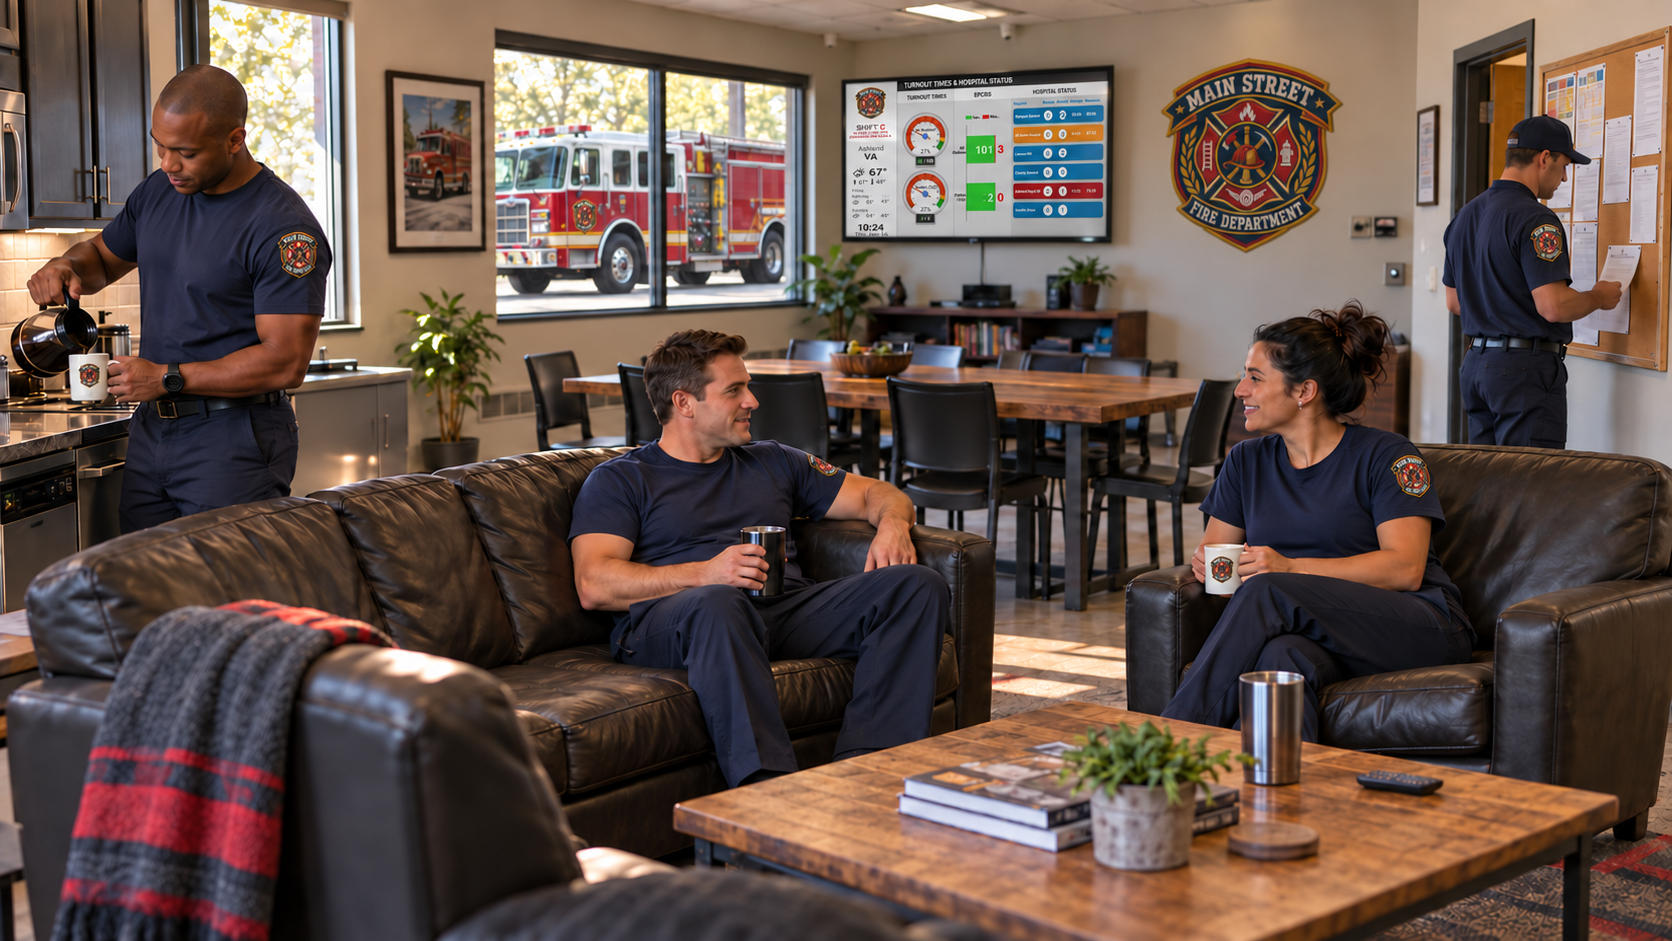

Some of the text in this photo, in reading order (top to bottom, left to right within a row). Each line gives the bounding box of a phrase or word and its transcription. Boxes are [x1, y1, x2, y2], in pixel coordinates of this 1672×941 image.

[904, 81, 932, 89] TURNOUT
[958, 78, 988, 86] HOSPITAL
[1185, 73, 1315, 112] MAIN STREET
[879, 123, 886, 131] C
[975, 145, 993, 154] 101
[997, 144, 1004, 154] 3
[864, 153, 878, 161] VA
[987, 192, 1004, 202] 2 0
[1189, 200, 1304, 230] FIRE DEPARTMENT
[857, 223, 884, 232] 10:24
